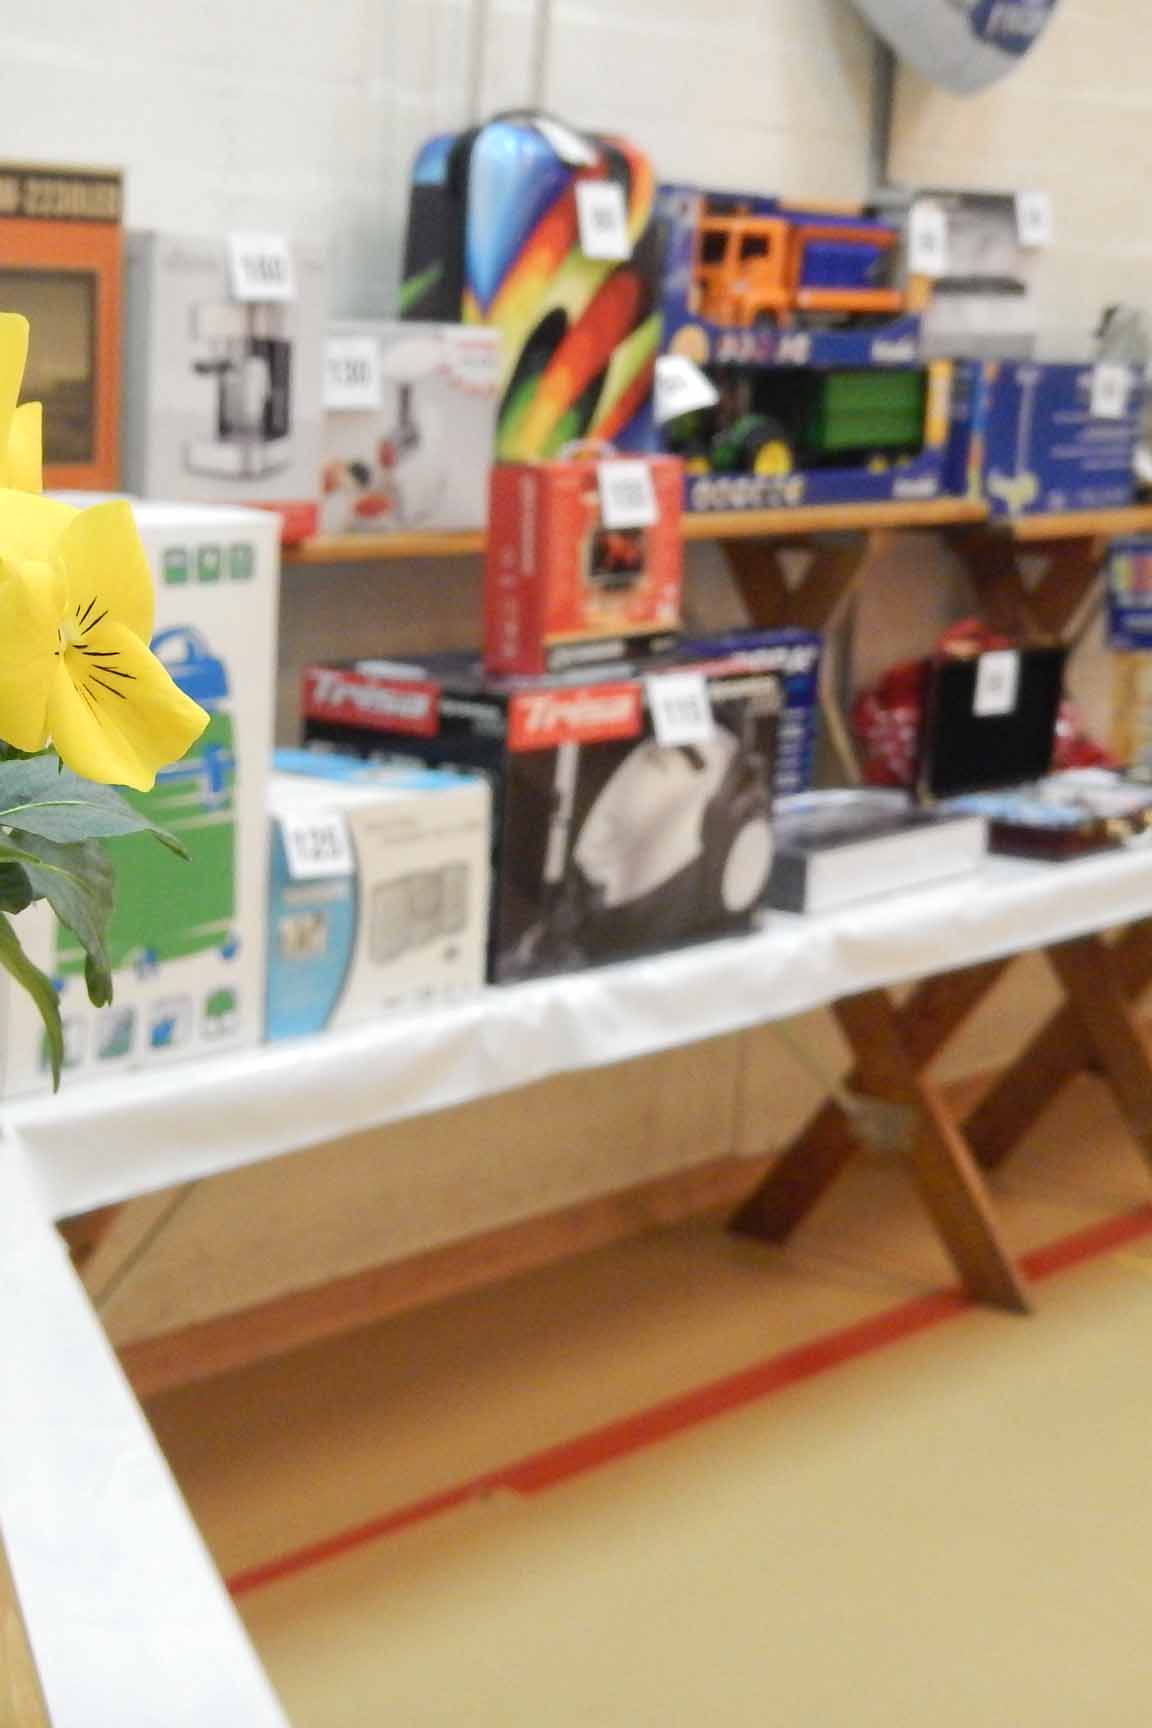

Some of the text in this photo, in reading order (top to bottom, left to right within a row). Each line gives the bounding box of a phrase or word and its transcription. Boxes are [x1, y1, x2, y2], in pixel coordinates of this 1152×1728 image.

[310, 670, 432, 720] Trisa
[517, 690, 633, 733] Trisa
[293, 825, 341, 862] 125
